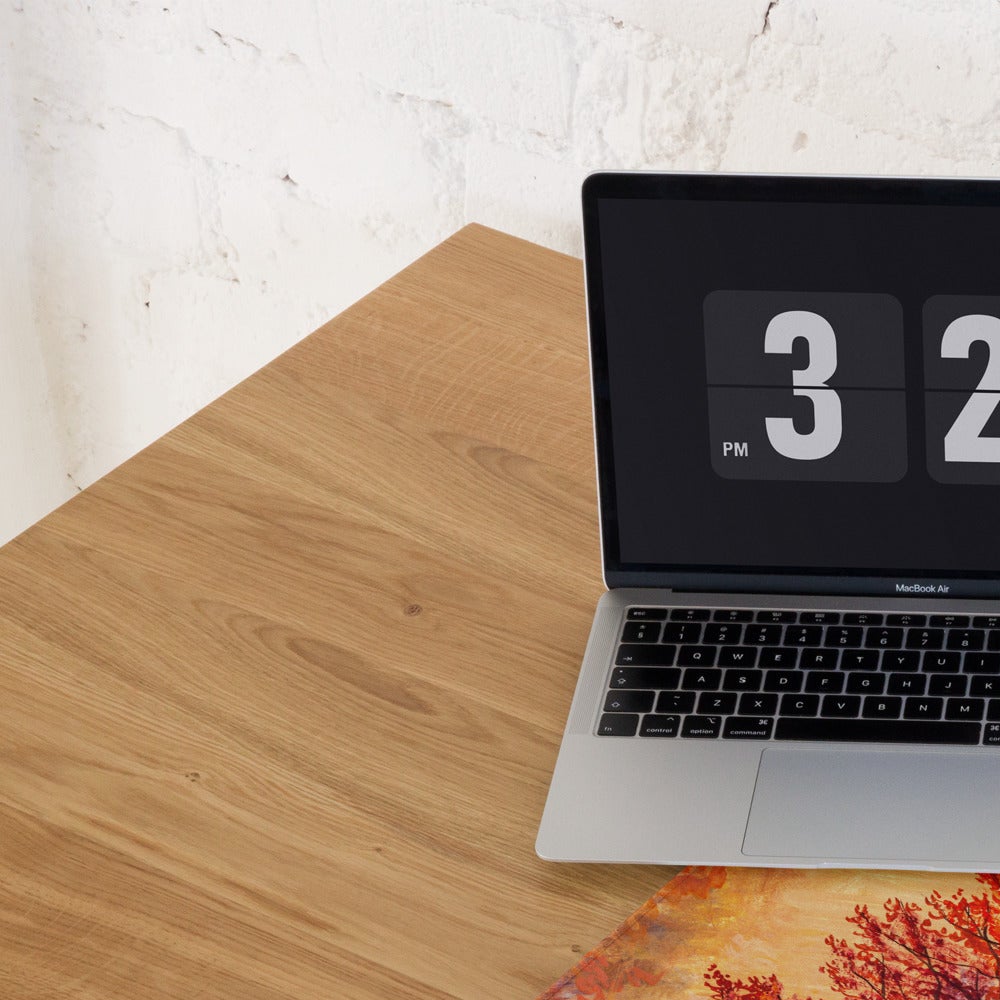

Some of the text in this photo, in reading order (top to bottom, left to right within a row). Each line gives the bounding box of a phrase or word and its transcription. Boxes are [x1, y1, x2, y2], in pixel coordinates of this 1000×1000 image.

[764, 310, 842, 460] 3
[723, 441, 748, 457] PM
[896, 584, 949, 593] MacBook Air
